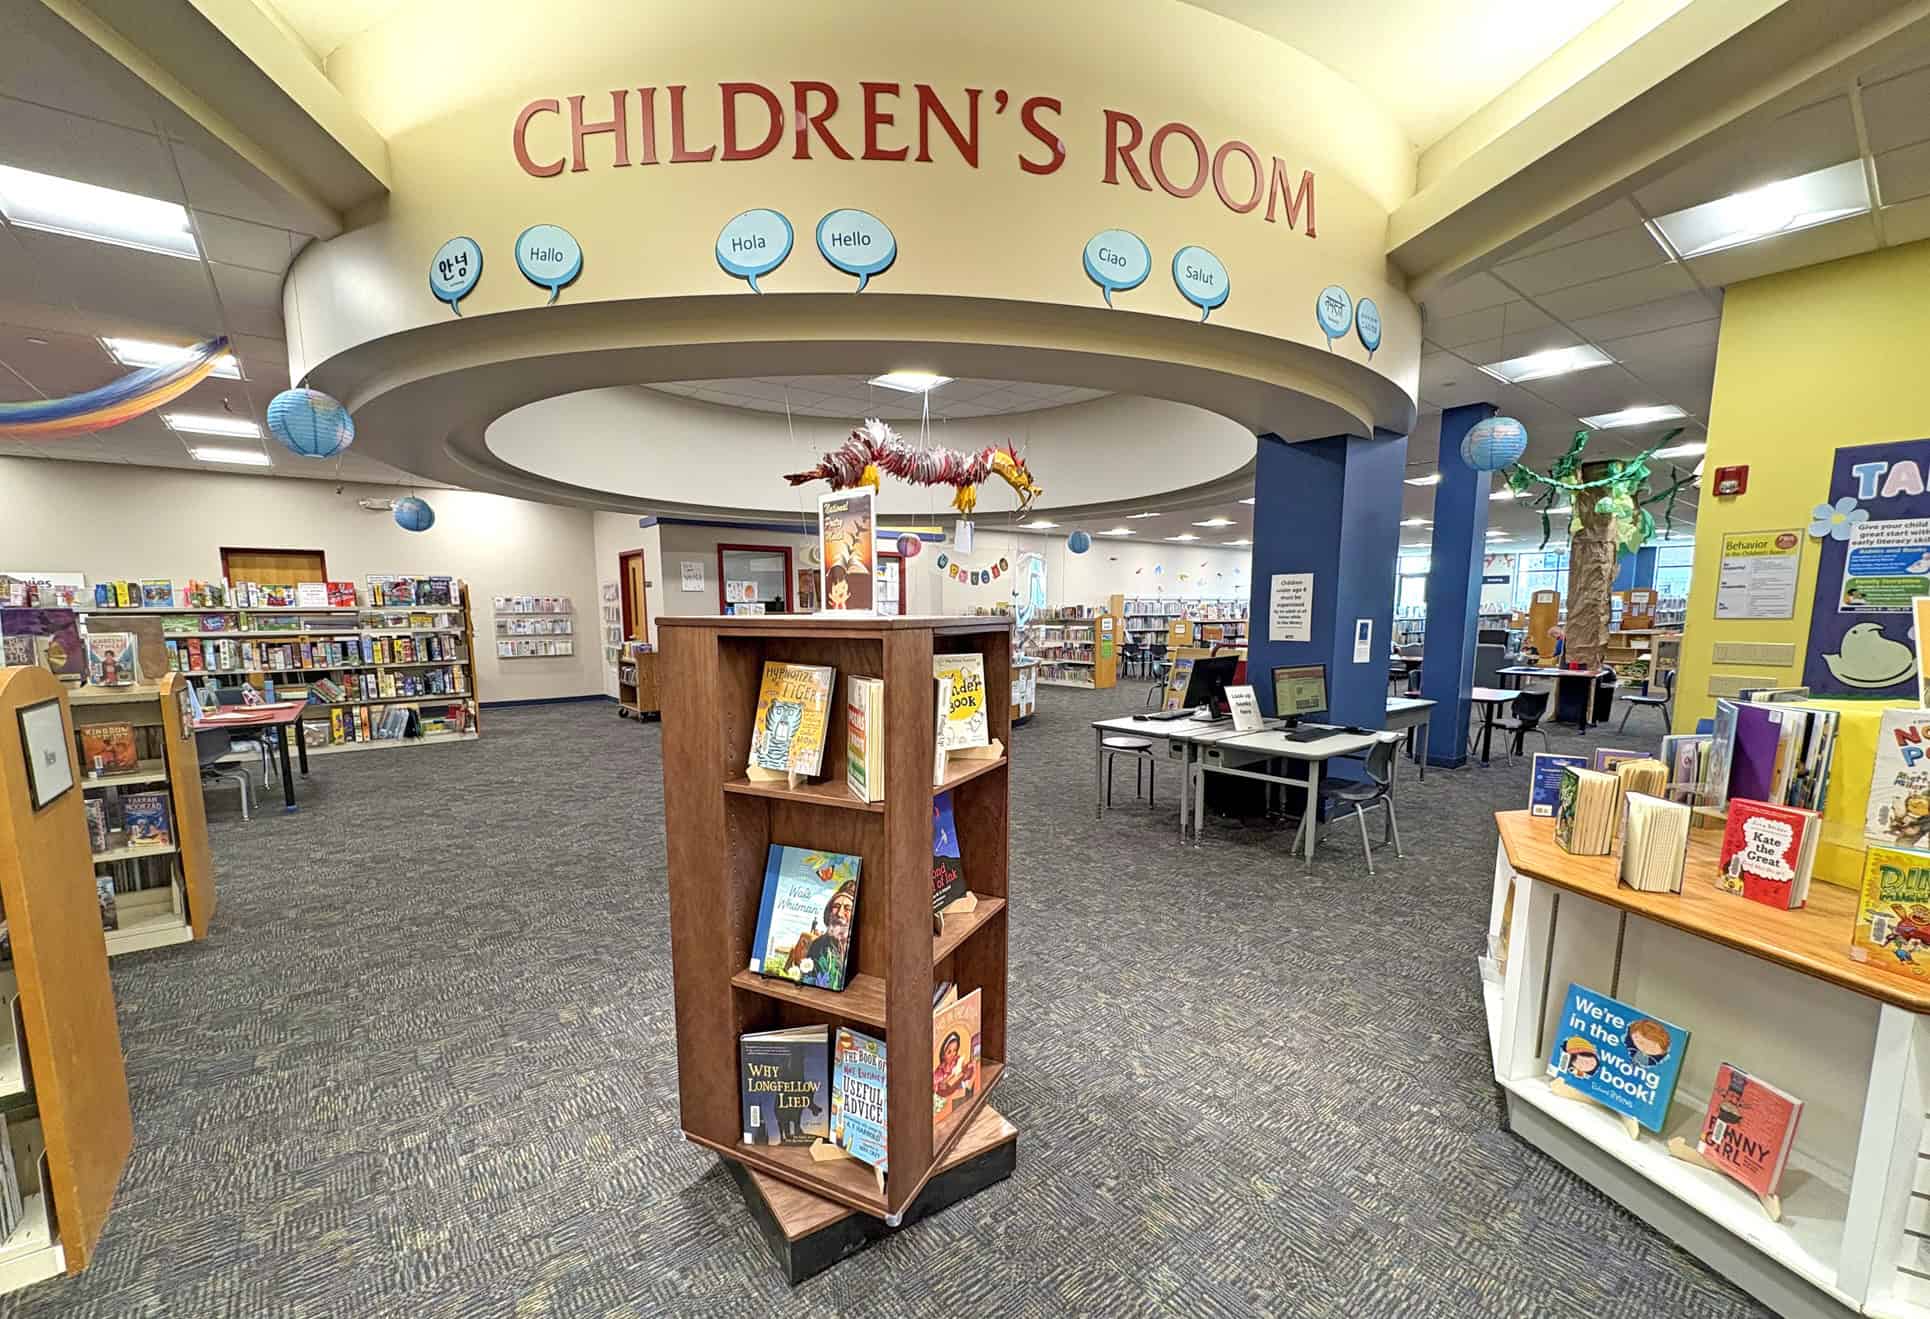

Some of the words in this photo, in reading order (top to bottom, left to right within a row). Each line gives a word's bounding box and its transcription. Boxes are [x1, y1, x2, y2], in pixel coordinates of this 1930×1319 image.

[513, 81, 1067, 178] CHILDREN'S
[1102, 109, 1317, 238] ROOM
[732, 235, 766, 252] Hola
[831, 232, 871, 248] Hello
[530, 248, 563, 262] Hallo
[1098, 247, 1127, 268] Ciao
[439, 251, 468, 281] 안녕
[1185, 265, 1214, 286] Salut
[1852, 461, 1930, 499] TA
[1858, 521, 1879, 531] Give
[1881, 522, 1902, 531] your
[1904, 519, 1928, 529] child
[1859, 530, 1884, 539] great
[1886, 528, 1908, 537] start
[1726, 540, 1769, 551] Behavior
[1851, 537, 1875, 547] early
[1876, 535, 1911, 546] literacy
[951, 680, 982, 697] nder
[1753, 832, 1781, 848] Kate
[1755, 844, 1775, 856] the
[1747, 850, 1781, 868] Great
[789, 884, 811, 900] Walt
[777, 899, 820, 915] Whitman
[1576, 995, 1625, 1029] We're
[1569, 1013, 1586, 1031] in
[1590, 1022, 1619, 1047] the
[844, 1050, 858, 1064] THE
[858, 1049, 877, 1067] BOOK
[748, 1063, 779, 1078] WHY
[1600, 1049, 1660, 1089] wrong
[748, 1078, 821, 1092] LONGFELLOW
[843, 1075, 883, 1106] USEFUL
[1600, 1067, 1656, 1105] book!
[779, 1093, 810, 1108] LIED
[843, 1094, 883, 1124] ADVICE
